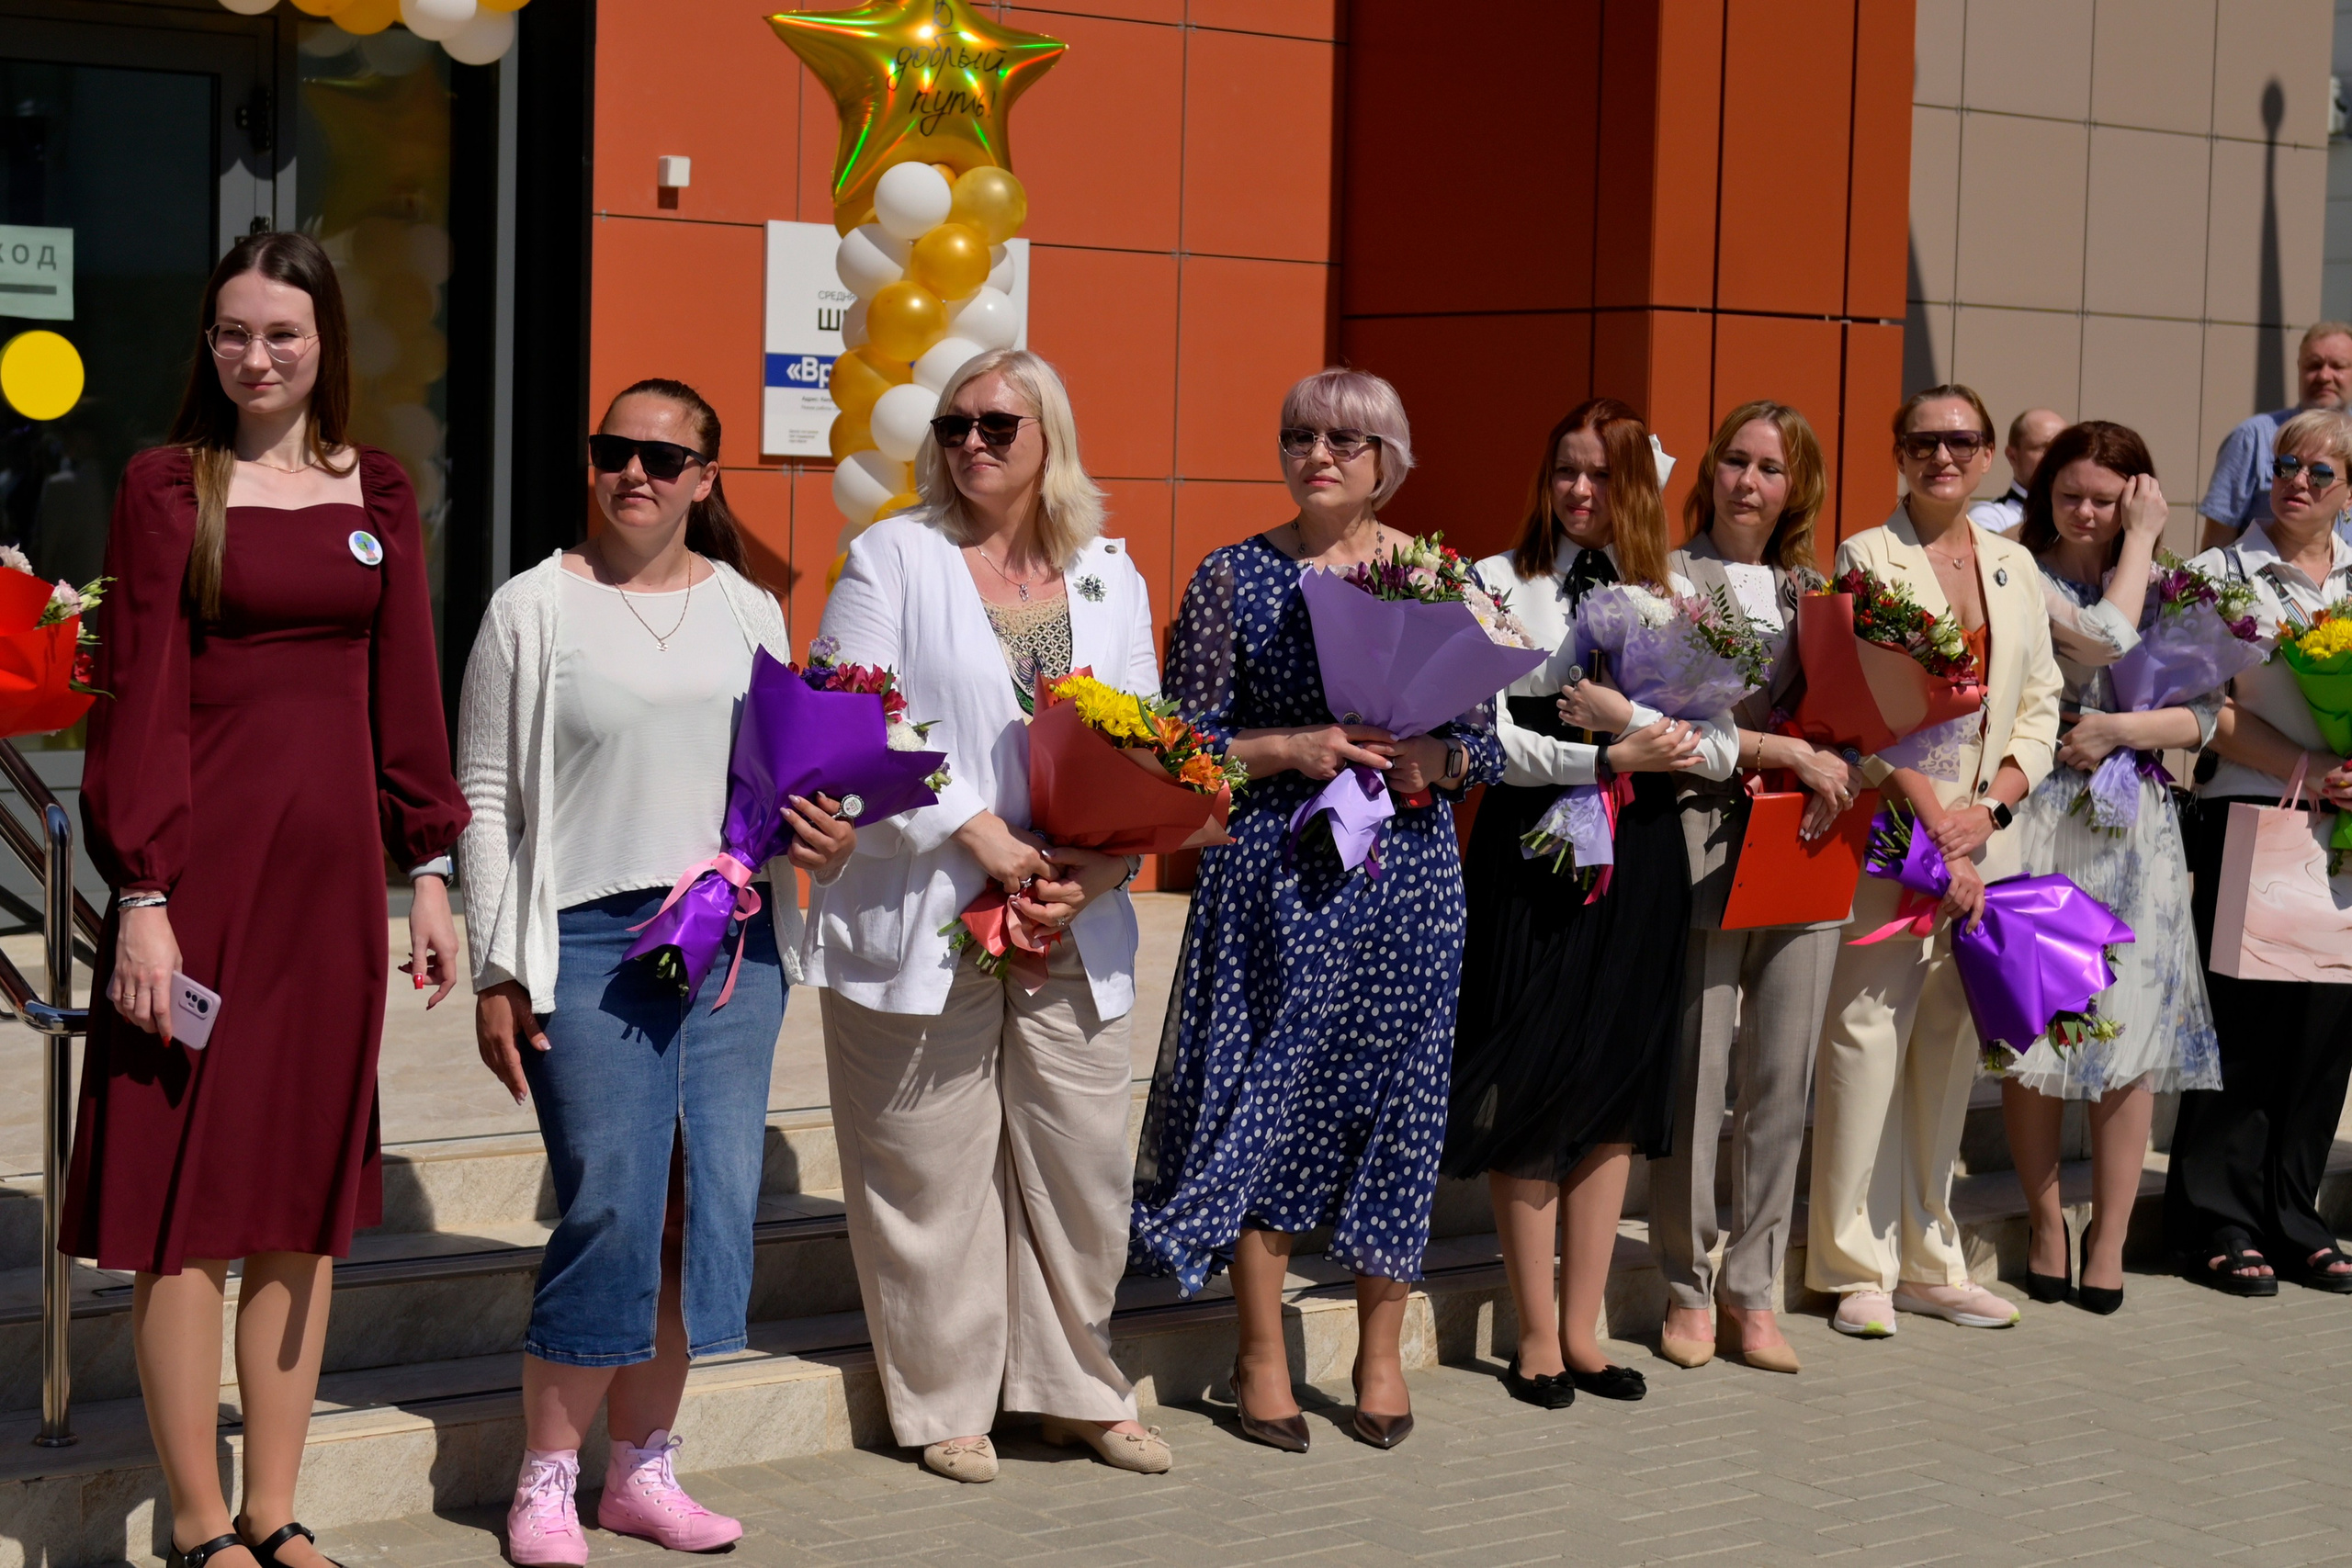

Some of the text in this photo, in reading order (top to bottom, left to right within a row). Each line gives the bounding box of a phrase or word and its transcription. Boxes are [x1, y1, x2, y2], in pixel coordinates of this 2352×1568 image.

[887, 31, 1007, 92] добрый
[909, 89, 997, 137] путь!
[0, 243, 57, 271] ОД
[818, 308, 848, 332] Ш
